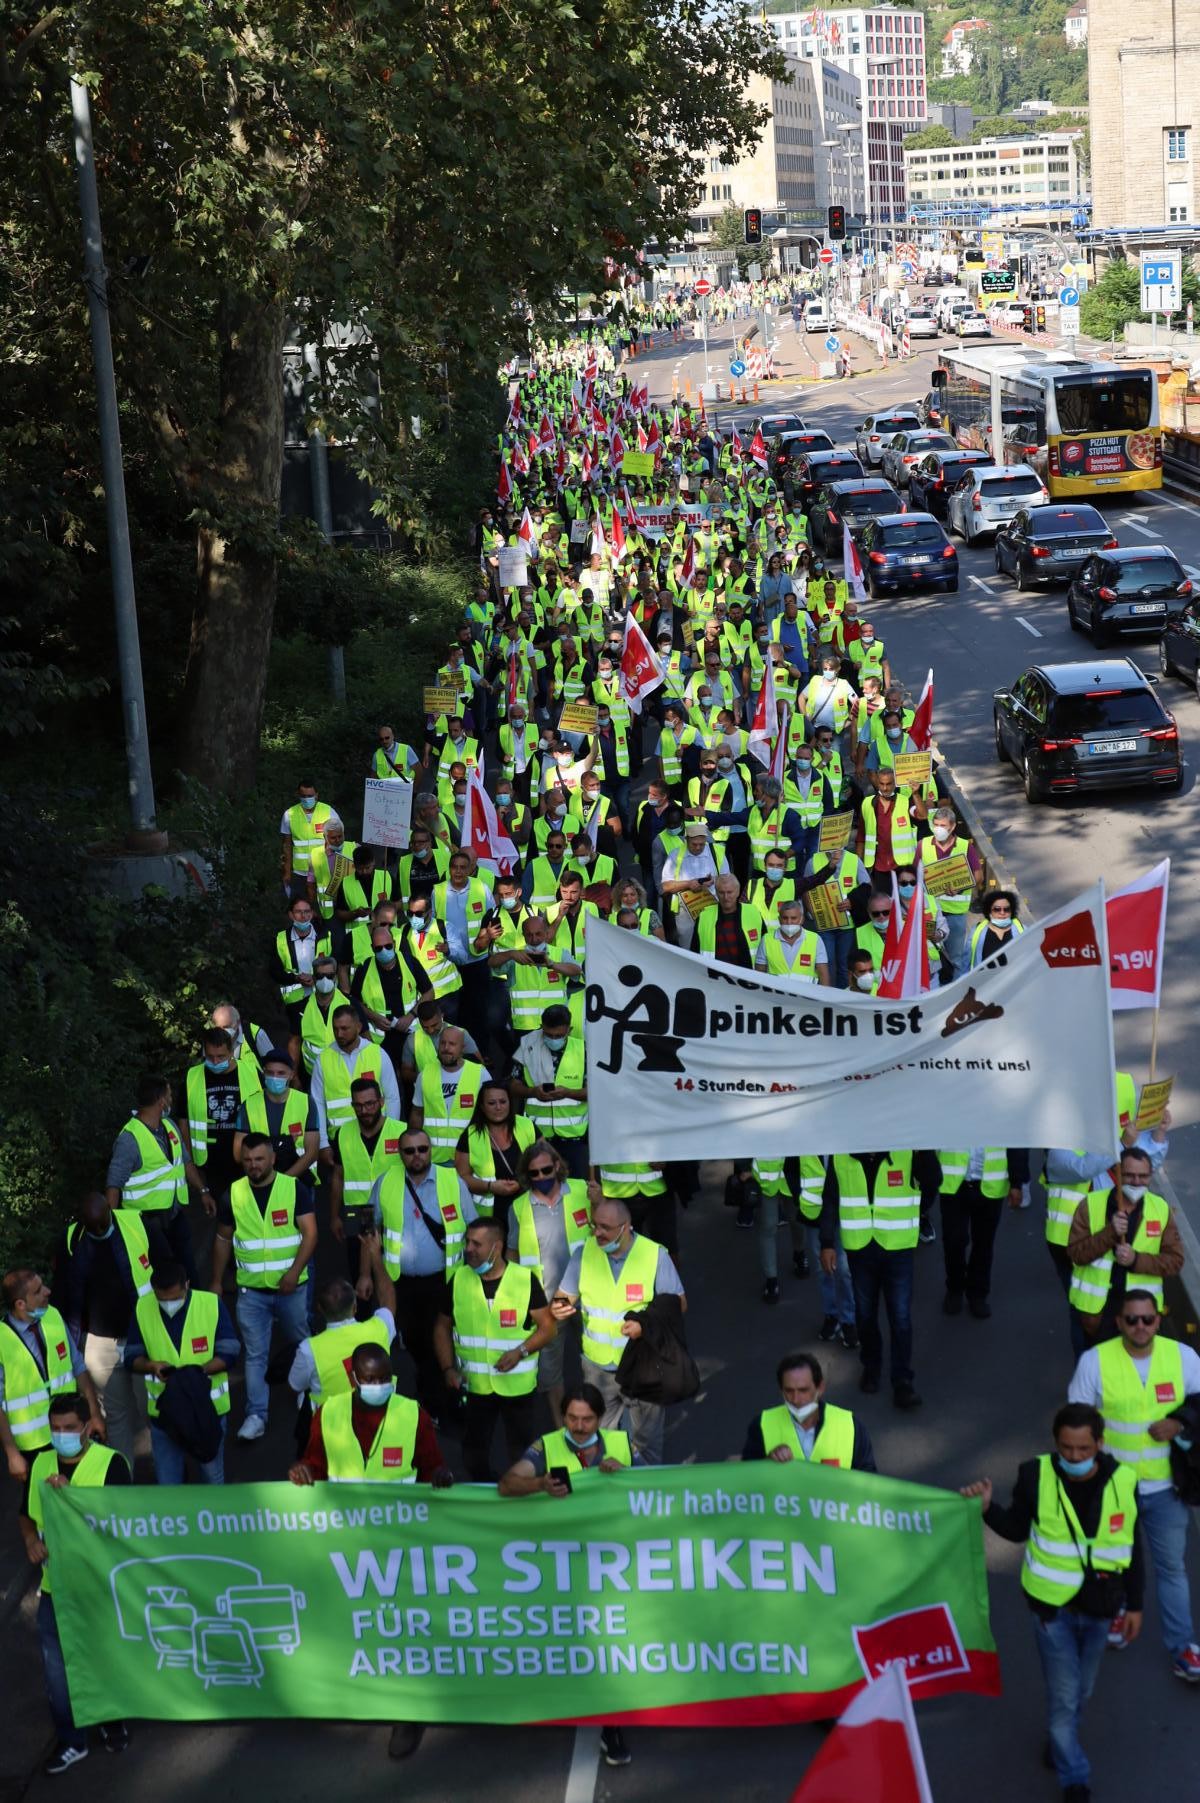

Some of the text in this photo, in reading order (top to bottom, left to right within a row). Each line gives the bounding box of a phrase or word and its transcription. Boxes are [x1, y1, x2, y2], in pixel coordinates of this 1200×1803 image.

[1147, 269, 1155, 280] P
[1089, 446, 1121, 455] STUTTGART
[1122, 740, 1135, 749] 173
[710, 1005, 923, 1038] pinkeln ist
[674, 1077, 694, 1091] 14
[698, 1079, 765, 1092] Stunden
[920, 1057, 961, 1070] nicht
[966, 1058, 993, 1070] mit
[998, 1060, 1031, 1071] uns!
[198, 1500, 429, 1535] Omnibusgewerbe
[628, 1489, 932, 1535] Wir haben es ver.dient!
[330, 1538, 837, 1599] WIR STREIKEN
[352, 1603, 627, 1640] FÜR BESSERE
[349, 1642, 808, 1677] ARBEITSBEDINGUNGEN
